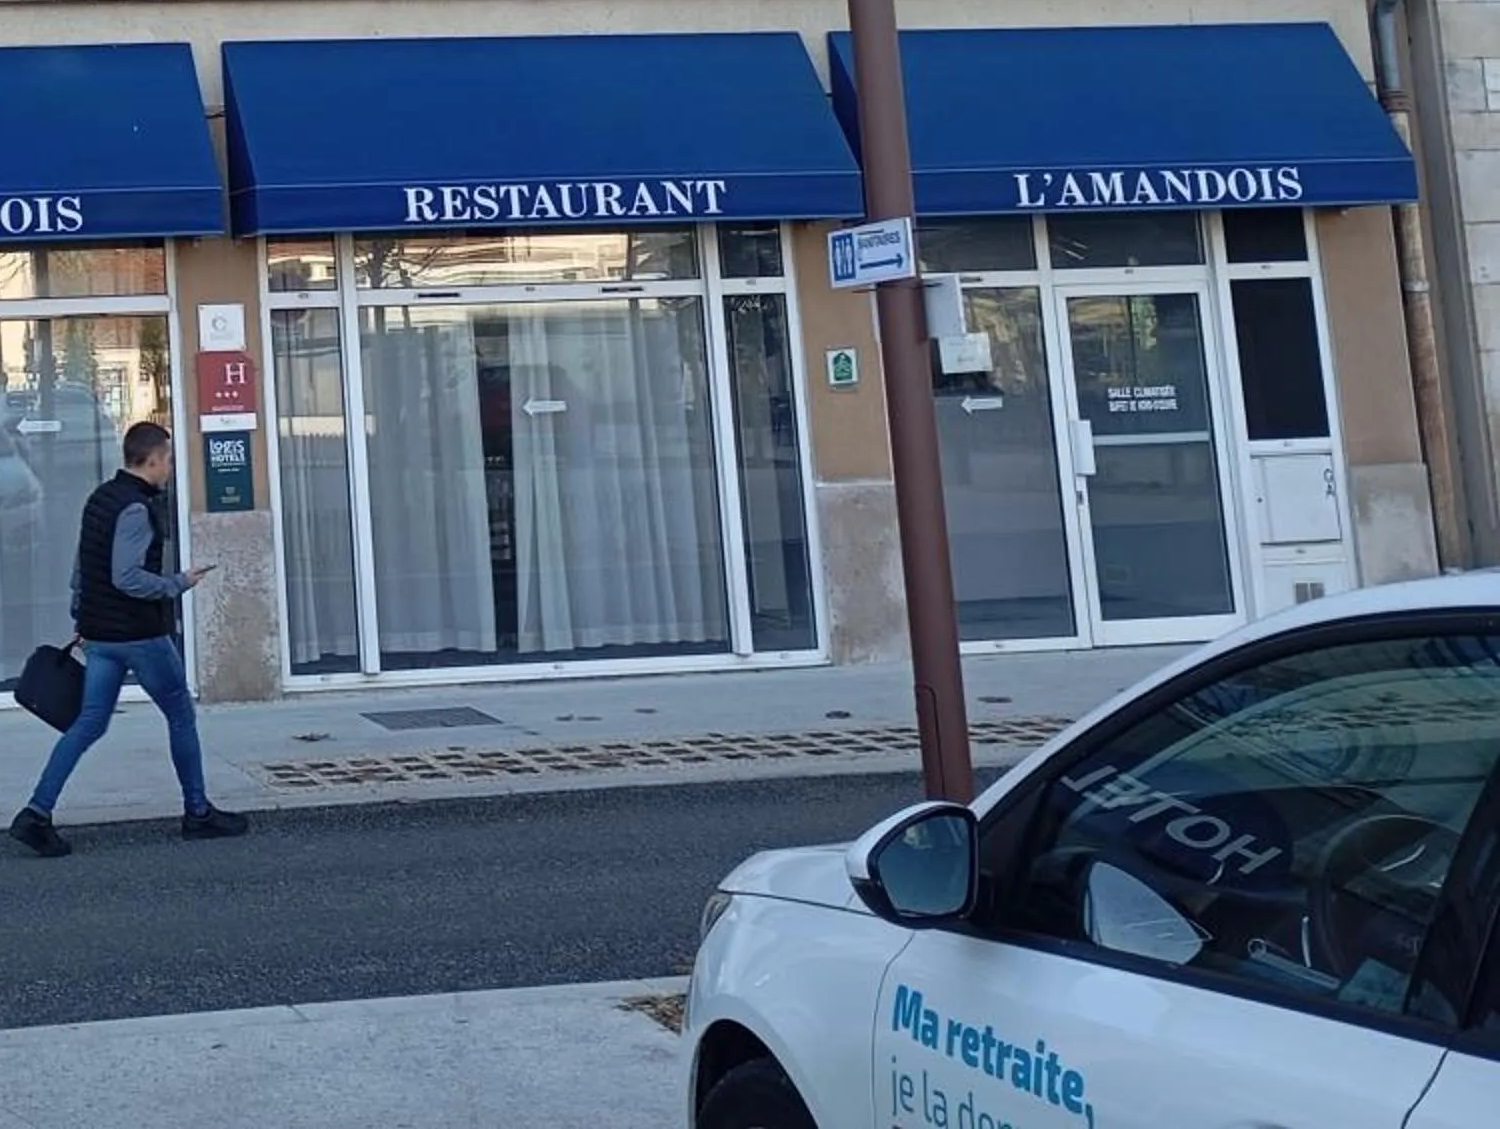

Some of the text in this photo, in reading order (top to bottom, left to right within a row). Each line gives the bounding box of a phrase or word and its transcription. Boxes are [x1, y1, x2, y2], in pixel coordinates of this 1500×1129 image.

[403, 179, 726, 223] RESTAURANT
[225, 362, 245, 384] H
[892, 984, 1096, 1129] Ma retraite,
[892, 1055, 914, 1117] je
[923, 1071, 948, 1128] la
